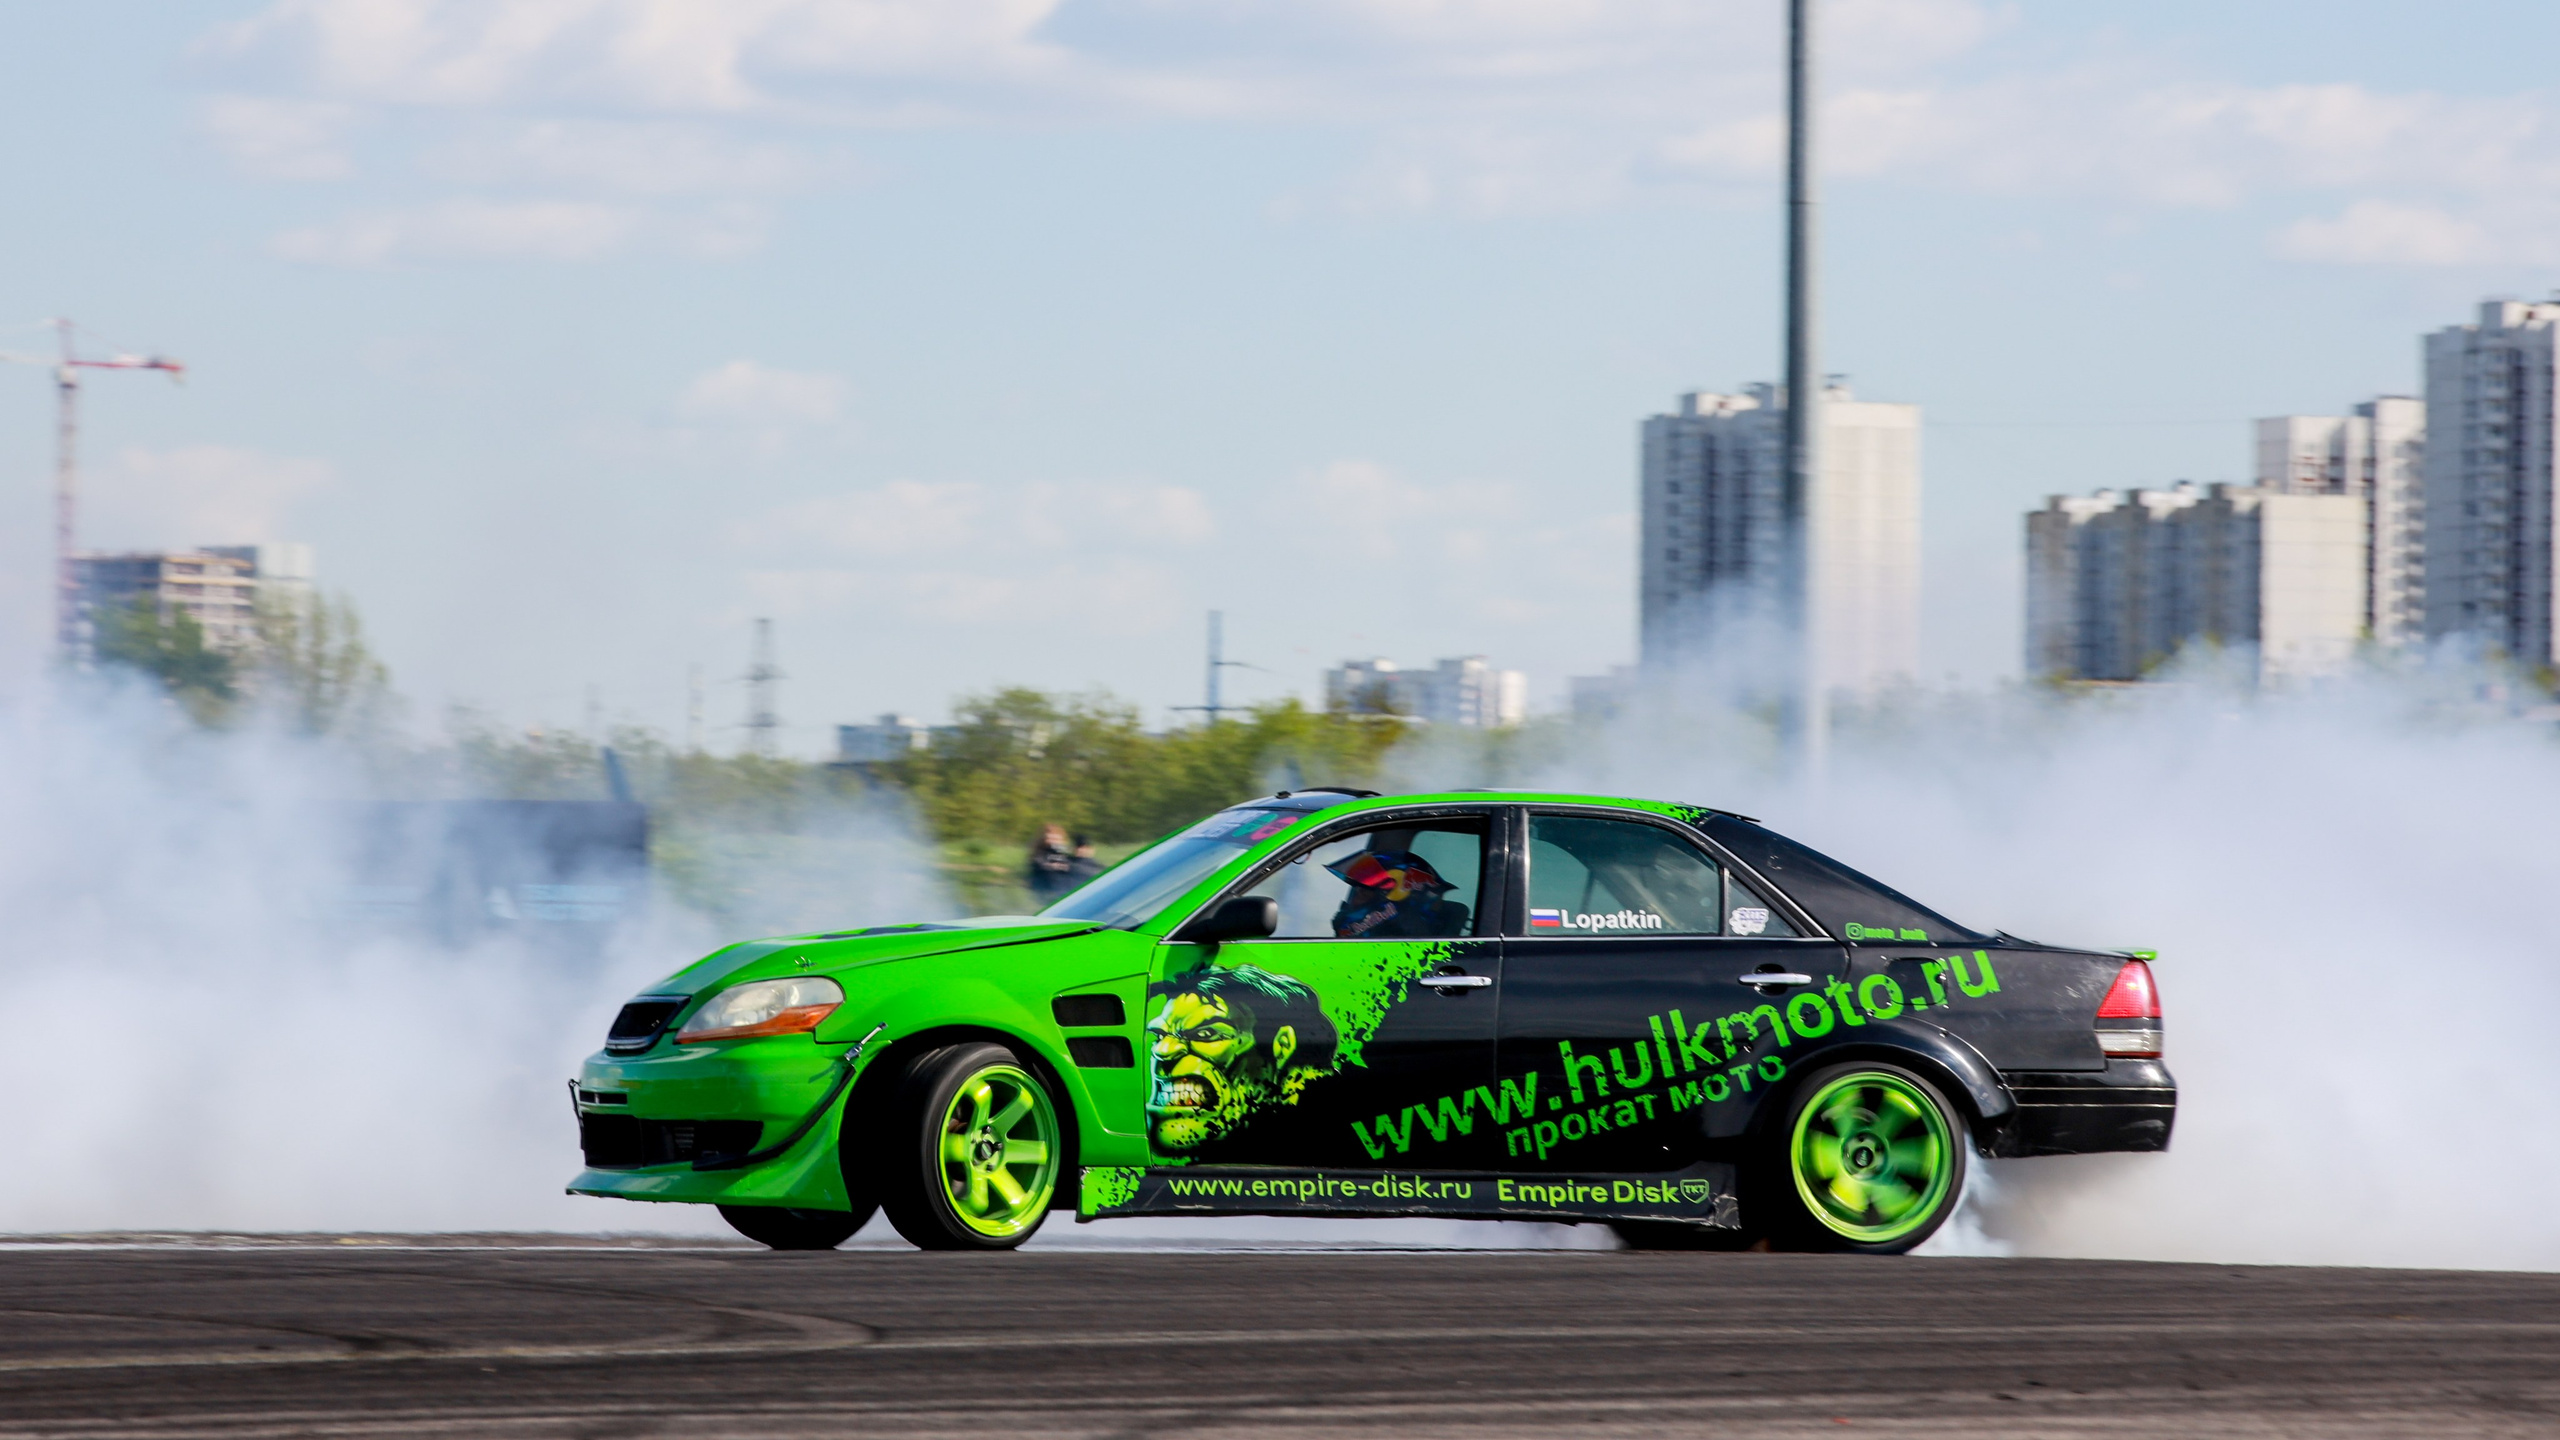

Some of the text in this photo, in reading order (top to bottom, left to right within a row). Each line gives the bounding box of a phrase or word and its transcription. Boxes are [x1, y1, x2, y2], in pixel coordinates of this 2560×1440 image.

[1560, 908, 1662, 934] Lopatkin
[1351, 949, 2001, 1160] www.hulkmoto.ru
[1506, 1095, 1656, 1160] прокат
[1168, 1173, 1472, 1202] www.empire-disk.ru
[1497, 1179, 1680, 1209] Empire Disk
